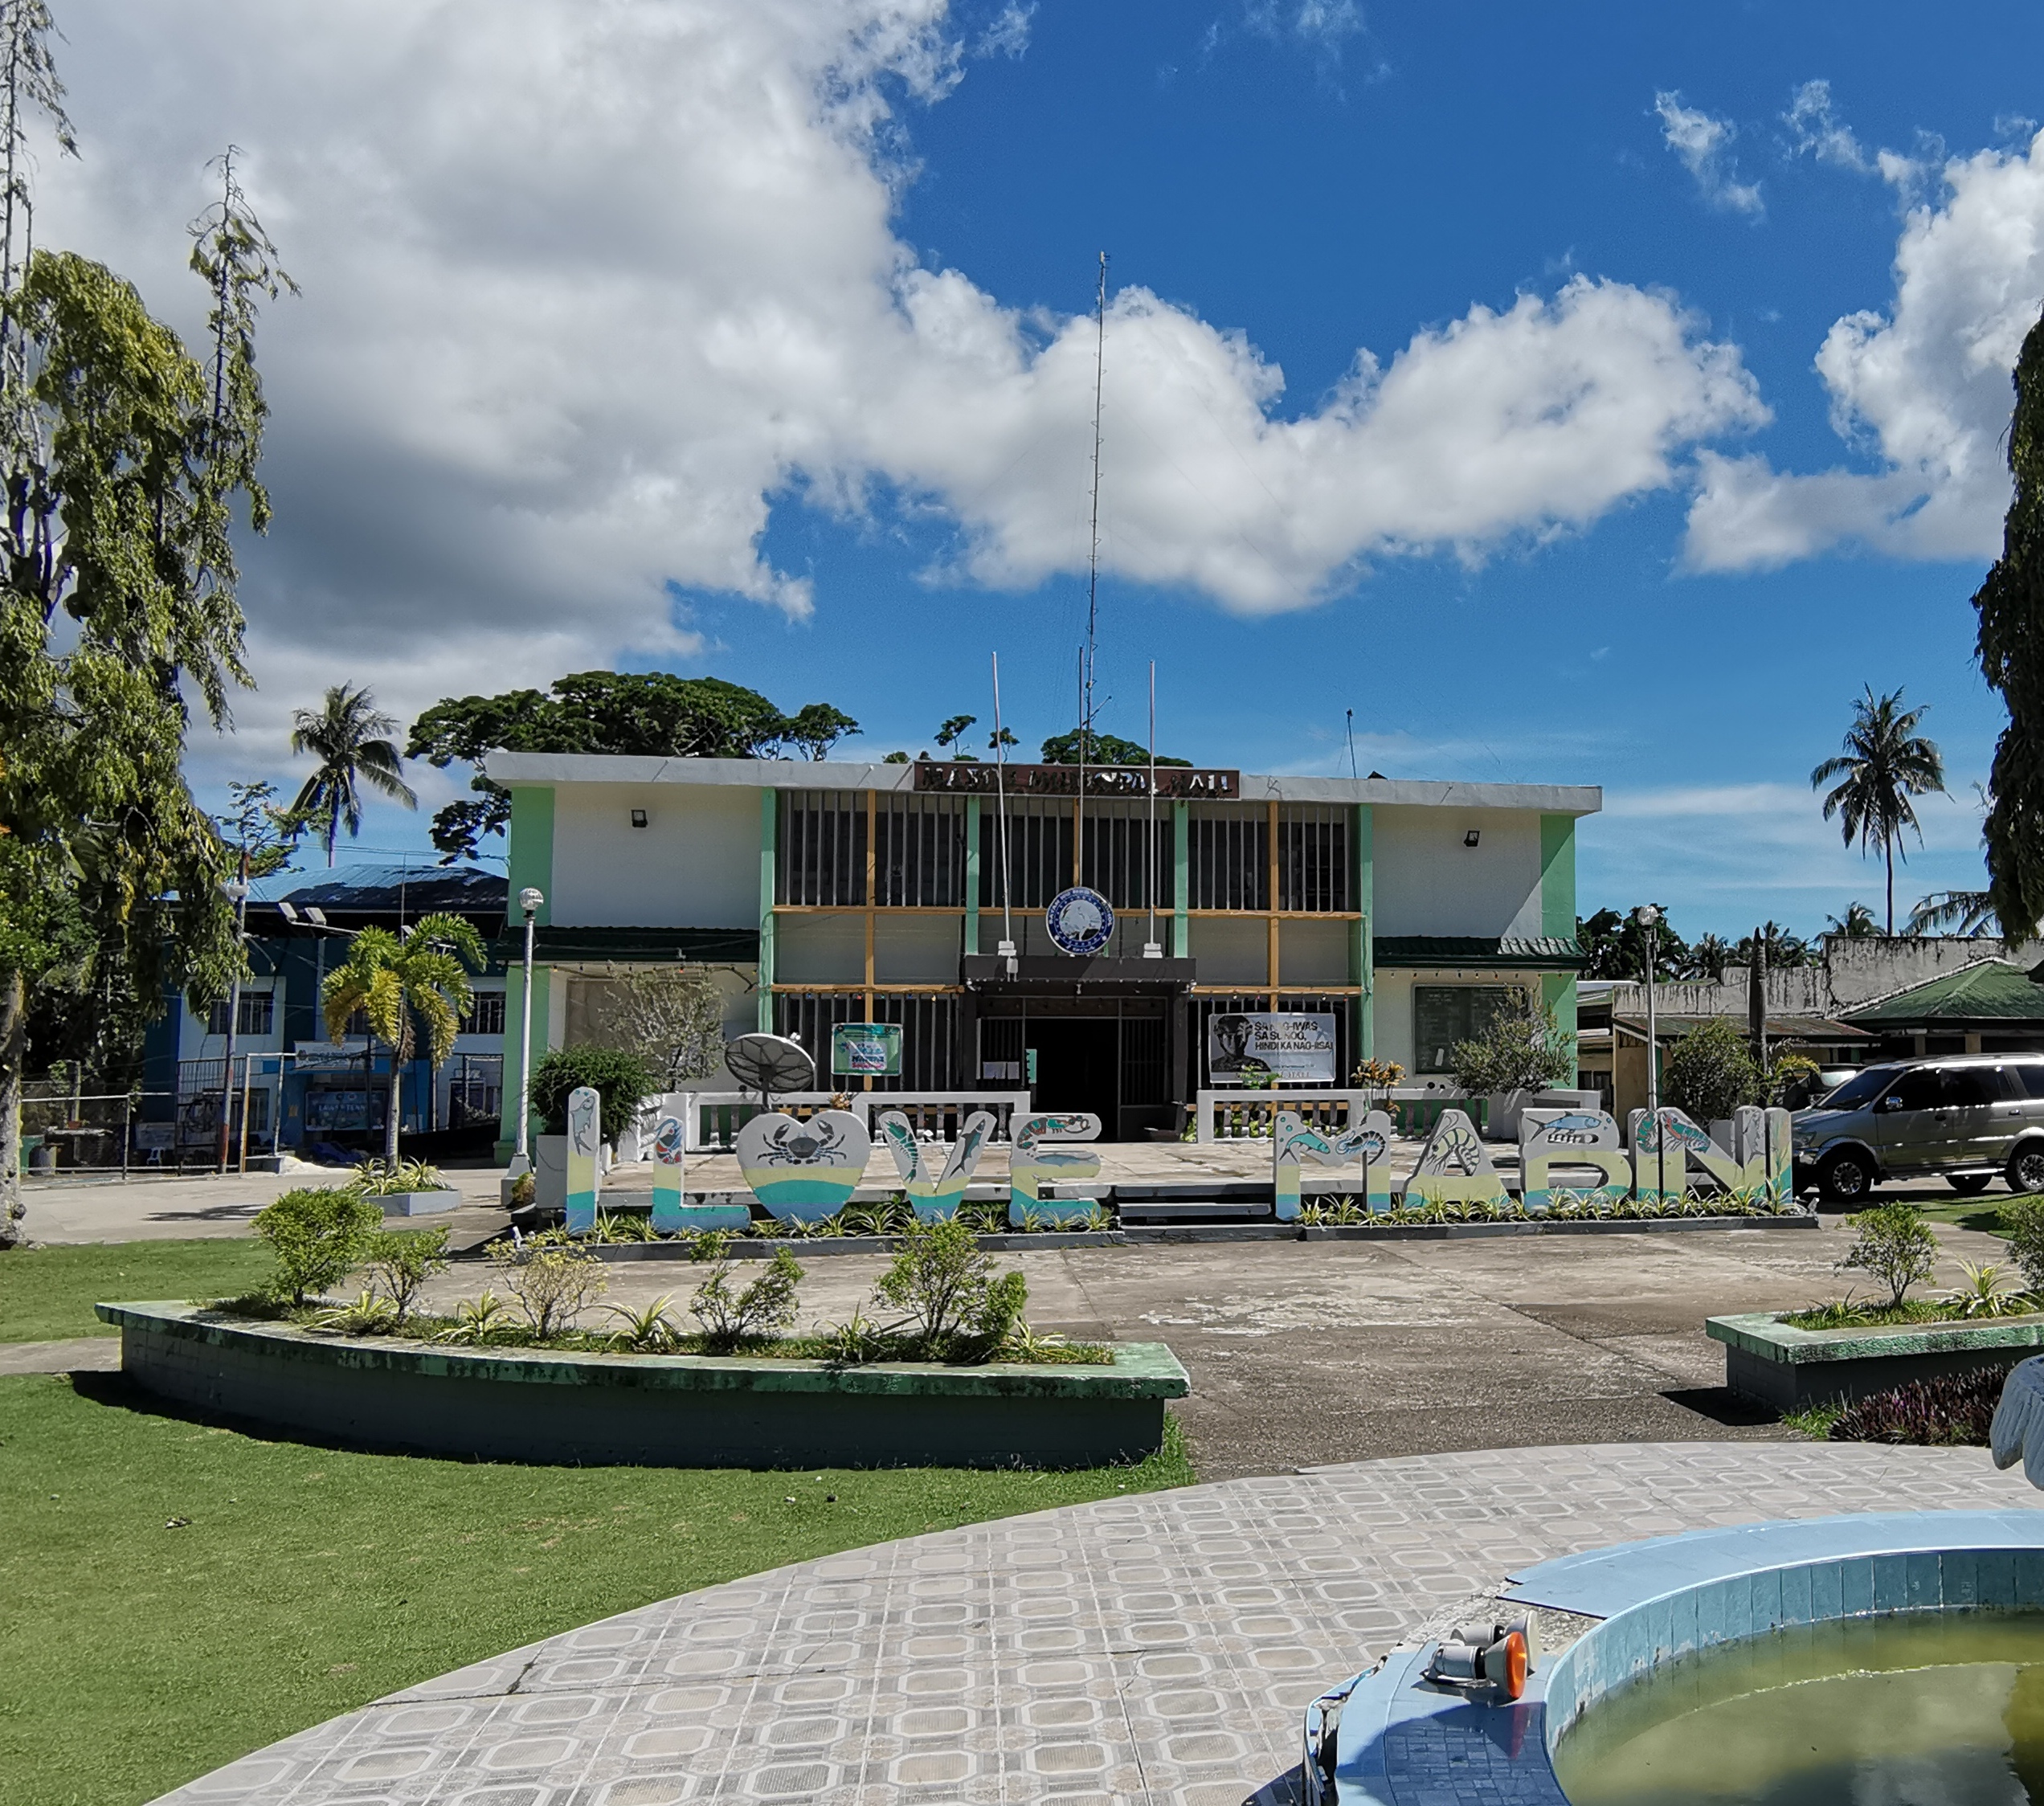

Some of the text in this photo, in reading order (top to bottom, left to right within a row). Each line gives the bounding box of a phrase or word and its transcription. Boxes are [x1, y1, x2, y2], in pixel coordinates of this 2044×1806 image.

[1254, 1031, 1269, 1040] SA
[1255, 1041, 1279, 1051] HINDI
[1280, 1041, 1292, 1050] KA
[1275, 1107, 1794, 1222] MABINI
